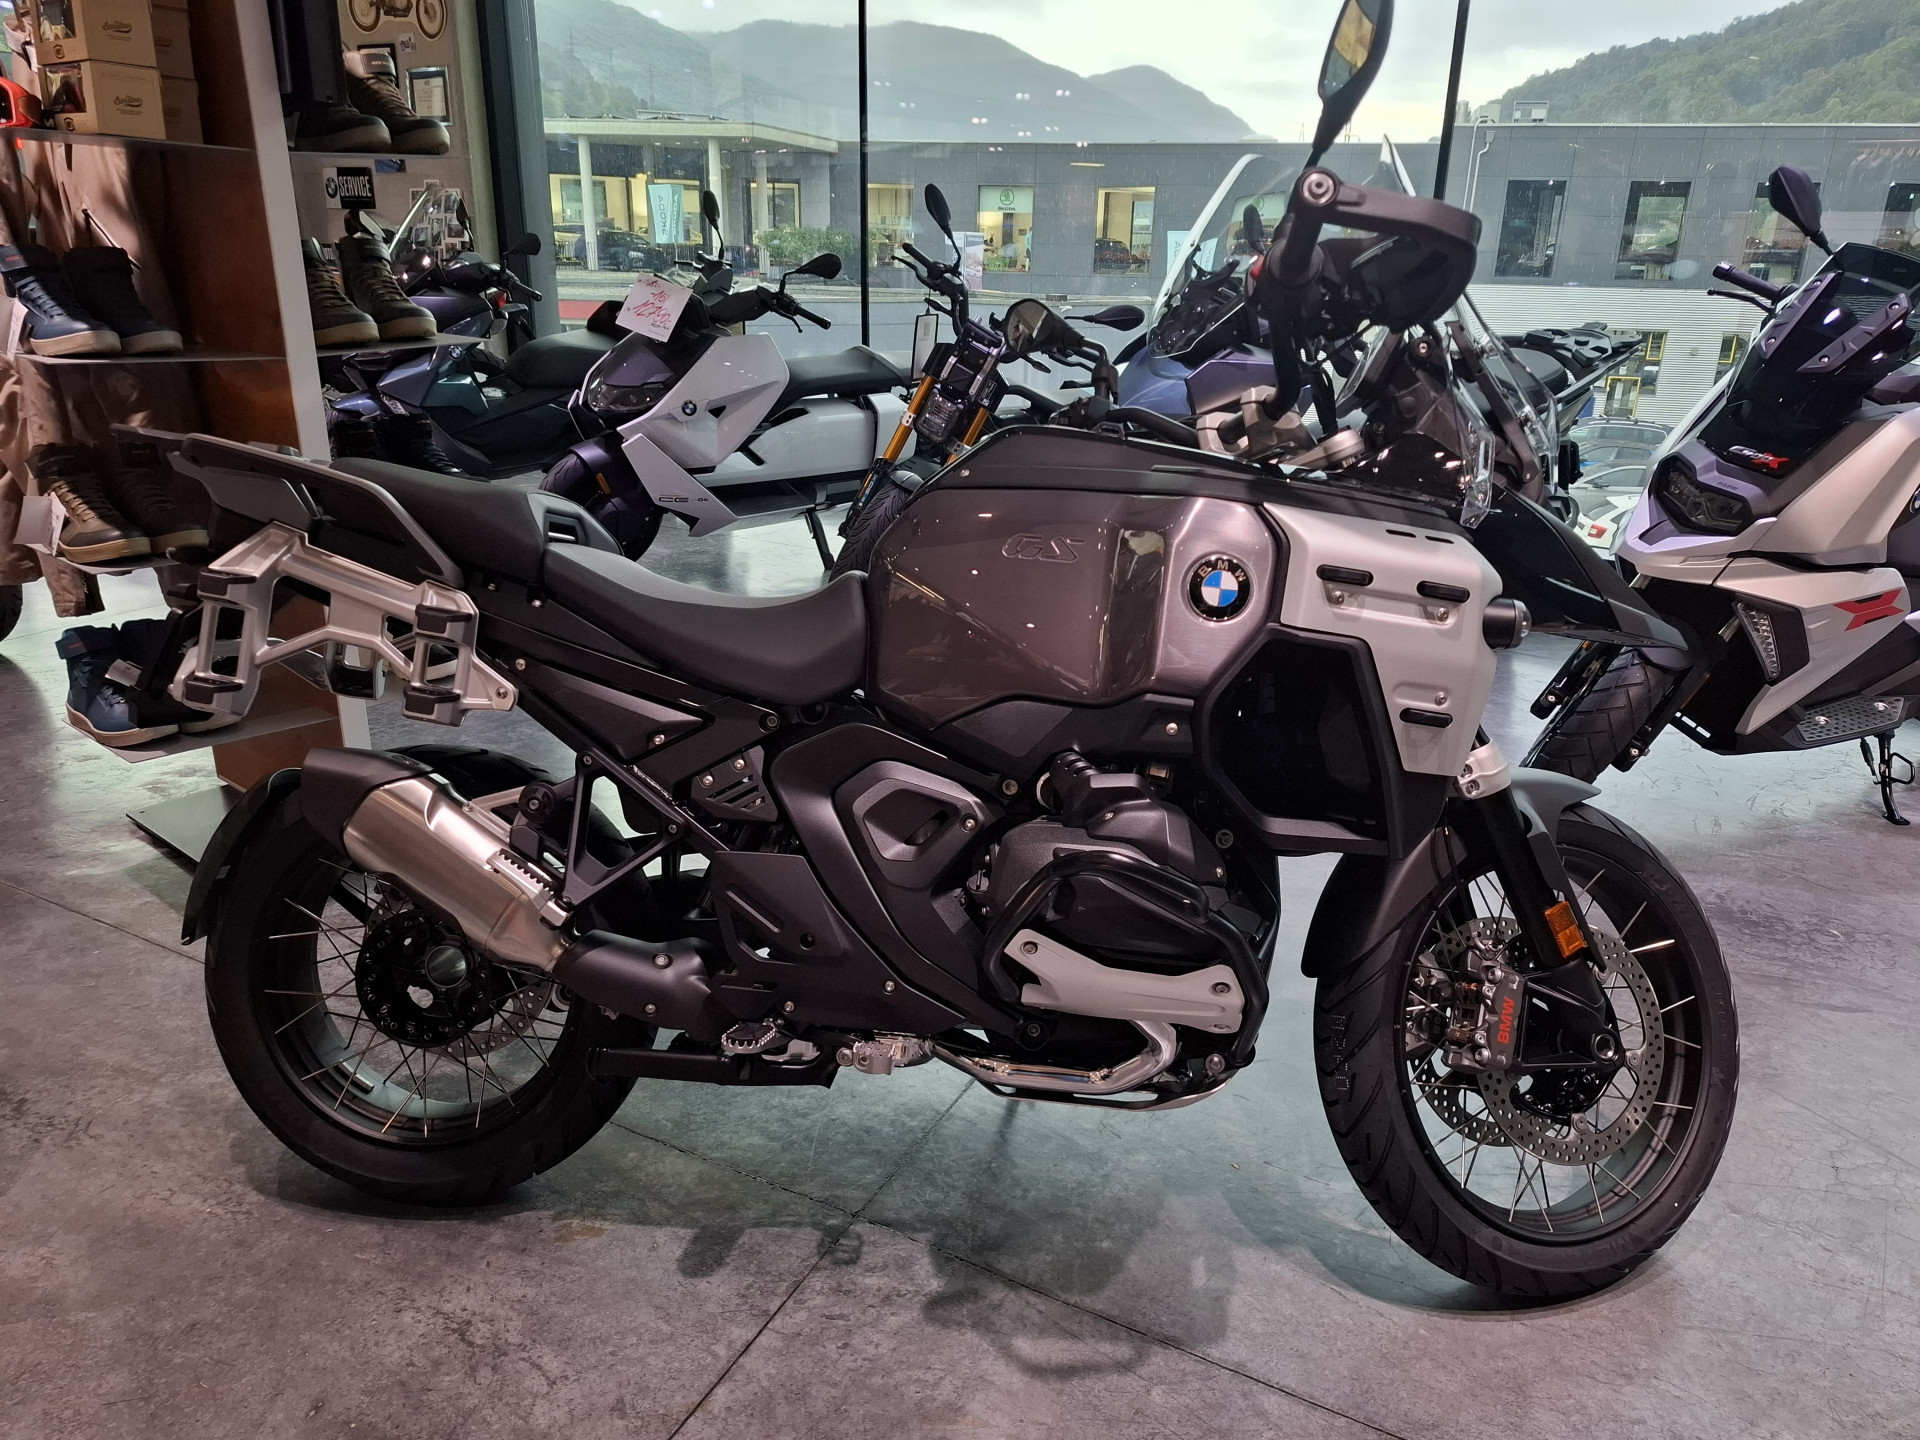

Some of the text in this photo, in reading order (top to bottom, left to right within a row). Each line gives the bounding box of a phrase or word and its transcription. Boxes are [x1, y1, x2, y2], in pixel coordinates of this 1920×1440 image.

[339, 176, 372, 197] SERVICE
[1002, 533, 1085, 563] GS
[1197, 560, 1247, 582] BMW
[1497, 995, 1516, 1044] BMW
